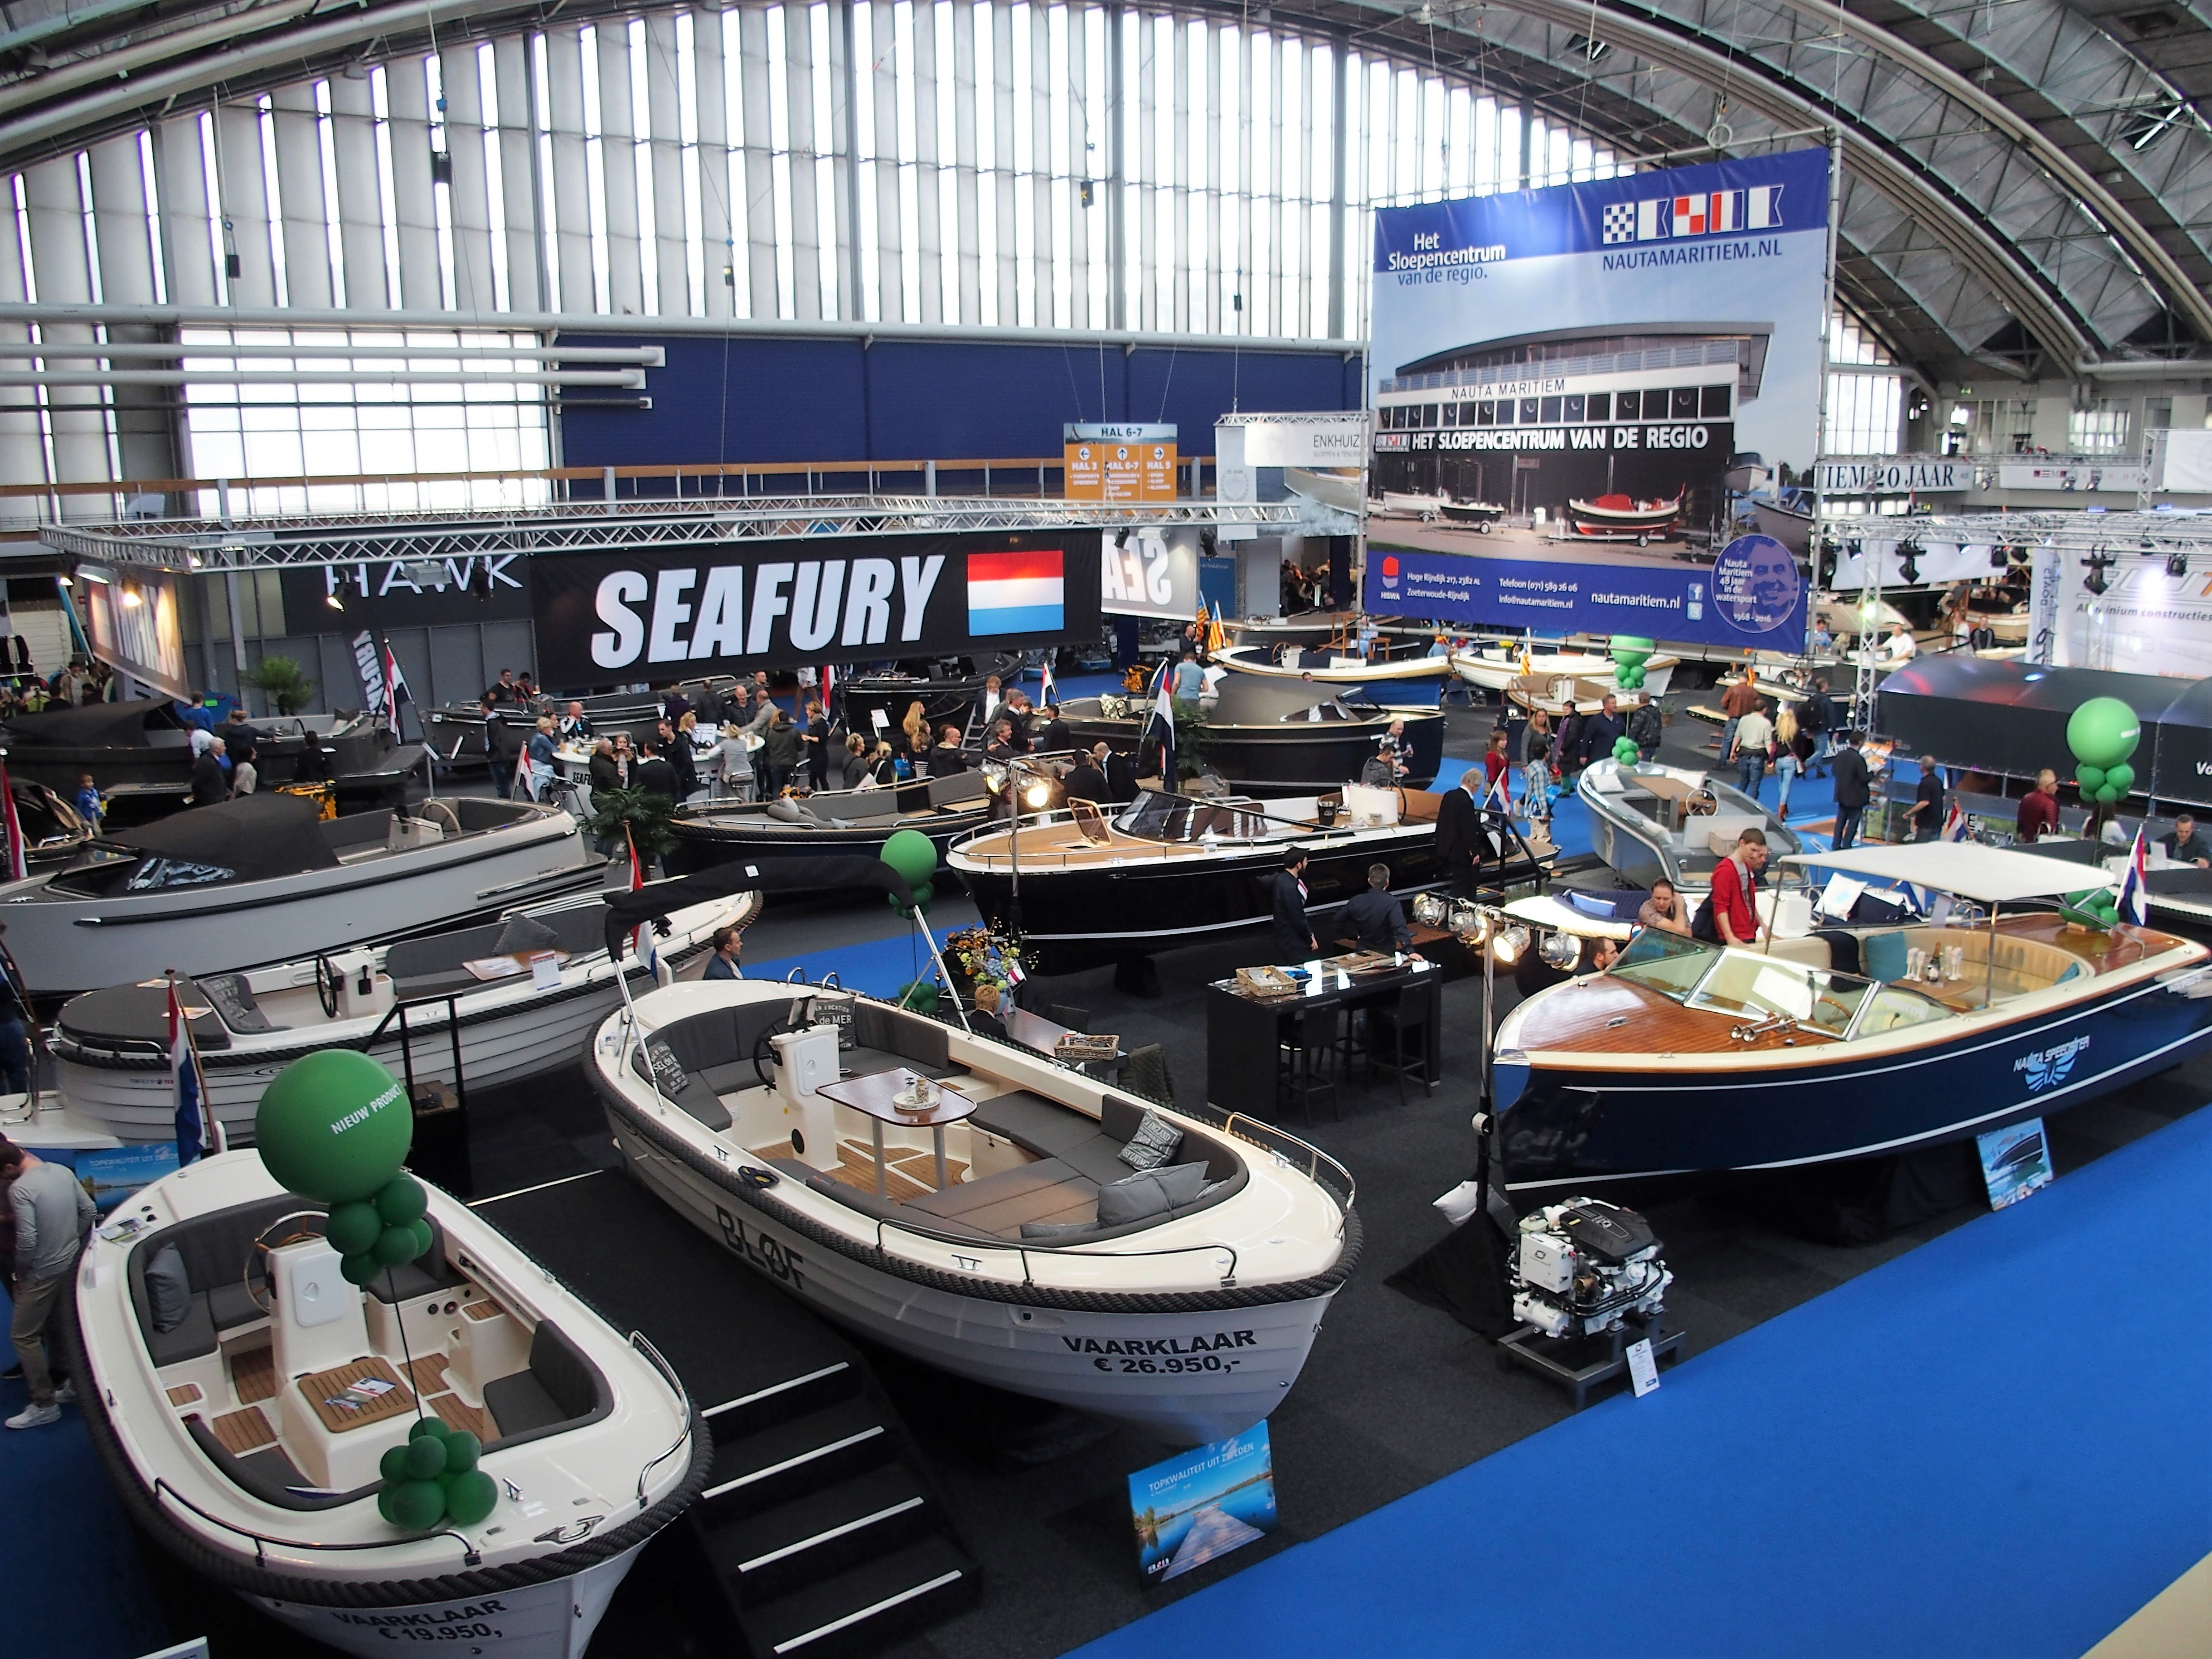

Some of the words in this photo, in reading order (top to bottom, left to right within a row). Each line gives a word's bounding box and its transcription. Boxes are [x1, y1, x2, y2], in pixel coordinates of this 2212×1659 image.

[1414, 232, 1439, 249] Het
[1388, 244, 1506, 272] Sloepencentrum
[1603, 240, 1783, 271] NAUTAMARITIEM.NL
[1398, 271, 1423, 286] van
[1425, 266, 1444, 284] de
[1447, 264, 1488, 286] regio.
[1451, 385, 1493, 400] NAUTA
[1498, 379, 1565, 397] MARITIEM
[1102, 428, 1123, 437] HAL
[1126, 428, 1142, 437] 6-7
[1411, 433, 1435, 450] HET
[1438, 430, 1565, 450] SLOEPENCENTRUM
[1570, 429, 1611, 449] VAN
[1615, 428, 1638, 449] DE
[1646, 426, 1709, 449] REGIO
[1313, 434, 1361, 448] ENKHUIZ
[1071, 462, 1090, 470] HAL
[1092, 462, 1097, 470] 3
[1107, 462, 1123, 470] HAL
[1147, 462, 1163, 470] HAL
[1822, 466, 1866, 489] IEM
[1875, 467, 1899, 488] 20
[1905, 465, 1954, 488] JAAR
[1724, 558, 1747, 568] Nauta
[1719, 567, 1753, 577] Maritiem
[1407, 573, 1423, 584] Hoge
[1458, 577, 1473, 586] 2382
[1500, 578, 1527, 589] Telefoon
[1527, 580, 1544, 591] (071)
[1544, 582, 1558, 592] 589
[1558, 583, 1567, 591] 26
[1568, 584, 1578, 592] 06
[1719, 577, 1729, 585] 48
[1380, 591, 1400, 601] HISWA
[1406, 588, 1470, 602] Zoeterwoude-Rijndijk
[1724, 585, 1732, 593] in
[1733, 585, 1743, 594] de
[1498, 595, 1574, 609] info@nautamaritiem.nl
[1591, 591, 1680, 609] nautamaritiem.nl
[1715, 593, 1757, 604] watersport
[591, 555, 946, 670] SEAFURY
[1733, 613, 1750, 622] 1968
[1755, 614, 1771, 623] 2016
[819, 1016, 831, 1025] de
[832, 1015, 852, 1024] MER
[331, 1106, 370, 1134] NIEUW
[370, 1083, 402, 1113] PRODUCT
[1147, 1121, 1171, 1142] ENGLAND
[1062, 1330, 1257, 1356] VAARKLAAR
[1094, 1357, 1113, 1372] €
[1120, 1355, 1240, 1374] 26.950,-
[1148, 1462, 1205, 1492] TOPKWALITEIT
[1207, 1456, 1220, 1468] UIT
[1222, 1442, 1254, 1462] ZEDEN
[331, 1600, 508, 1626] VAARKLAAR
